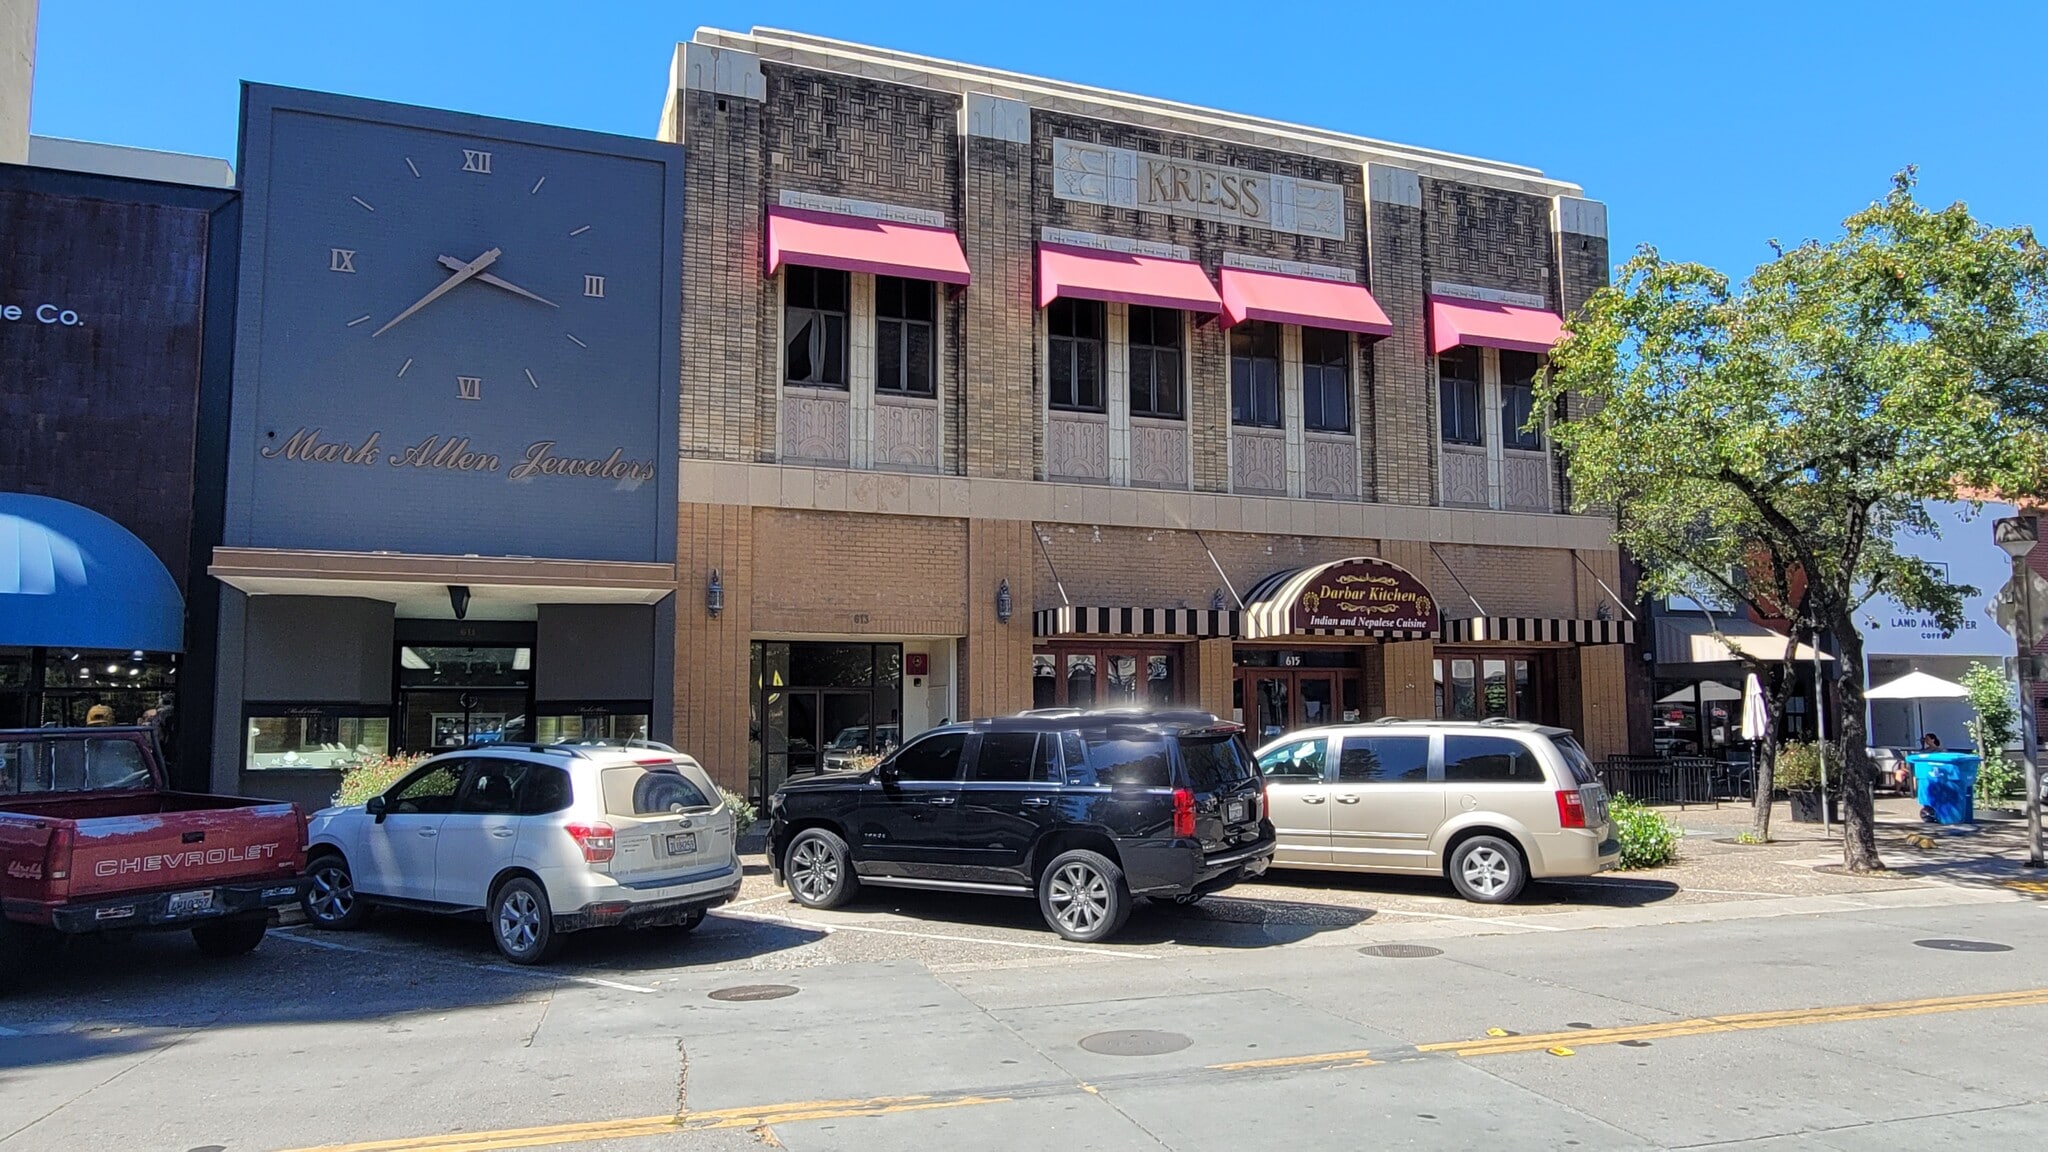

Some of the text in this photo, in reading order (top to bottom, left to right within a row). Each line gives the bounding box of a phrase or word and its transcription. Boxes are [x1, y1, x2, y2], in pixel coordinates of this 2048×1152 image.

[462, 149, 492, 174] XII
[1147, 160, 1260, 218] KRESS
[330, 248, 356, 273] IX
[583, 274, 605, 297] III
[36, 303, 84, 326] Co.
[456, 376, 481, 400] VI
[261, 427, 655, 480] Mark Allen Jewelers
[1320, 585, 1417, 602] Darbar Kitchen
[853, 613, 869, 625] 613
[1310, 615, 1427, 629] Indian and Nepalese Cuisine
[1891, 618, 1917, 628] LAND
[1920, 632, 1950, 640] COFF
[1285, 656, 1301, 666] 615
[95, 843, 279, 877] CHEVROLET
